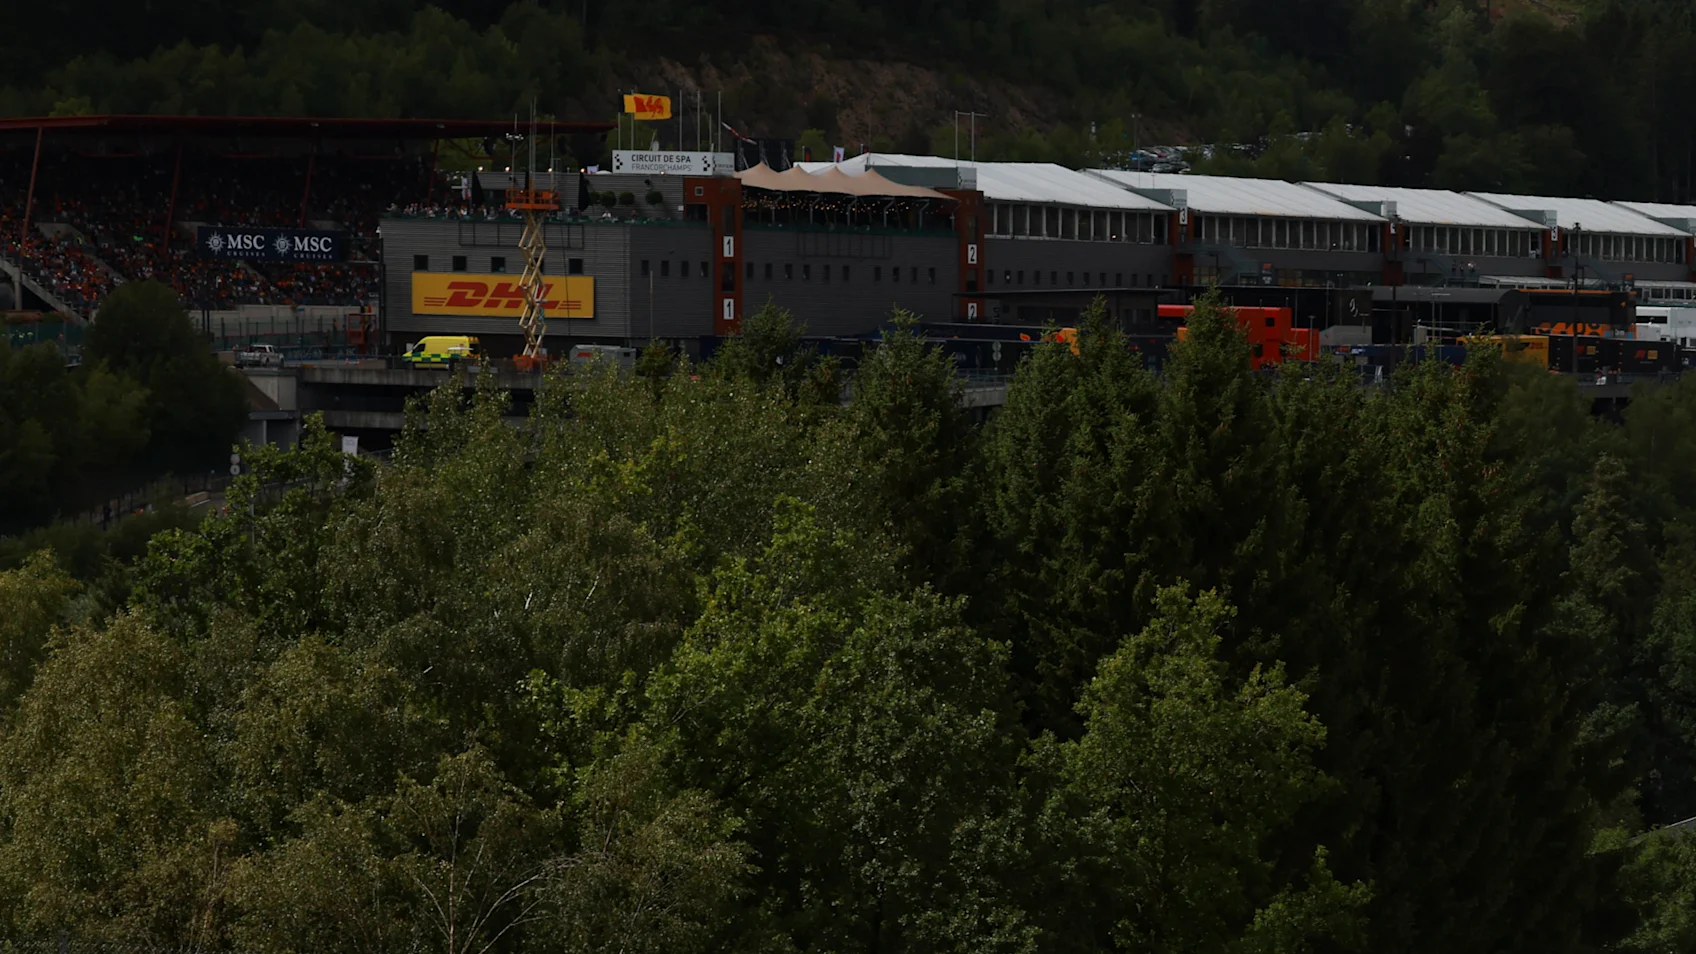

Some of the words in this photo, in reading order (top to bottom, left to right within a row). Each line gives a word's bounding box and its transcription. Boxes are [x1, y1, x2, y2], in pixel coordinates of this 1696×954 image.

[632, 154, 662, 163] CIRCUIT
[664, 154, 674, 163] DE
[676, 155, 691, 164] SPA
[227, 233, 266, 250] MSC
[294, 236, 333, 252] MSC
[445, 281, 561, 309] DHL
